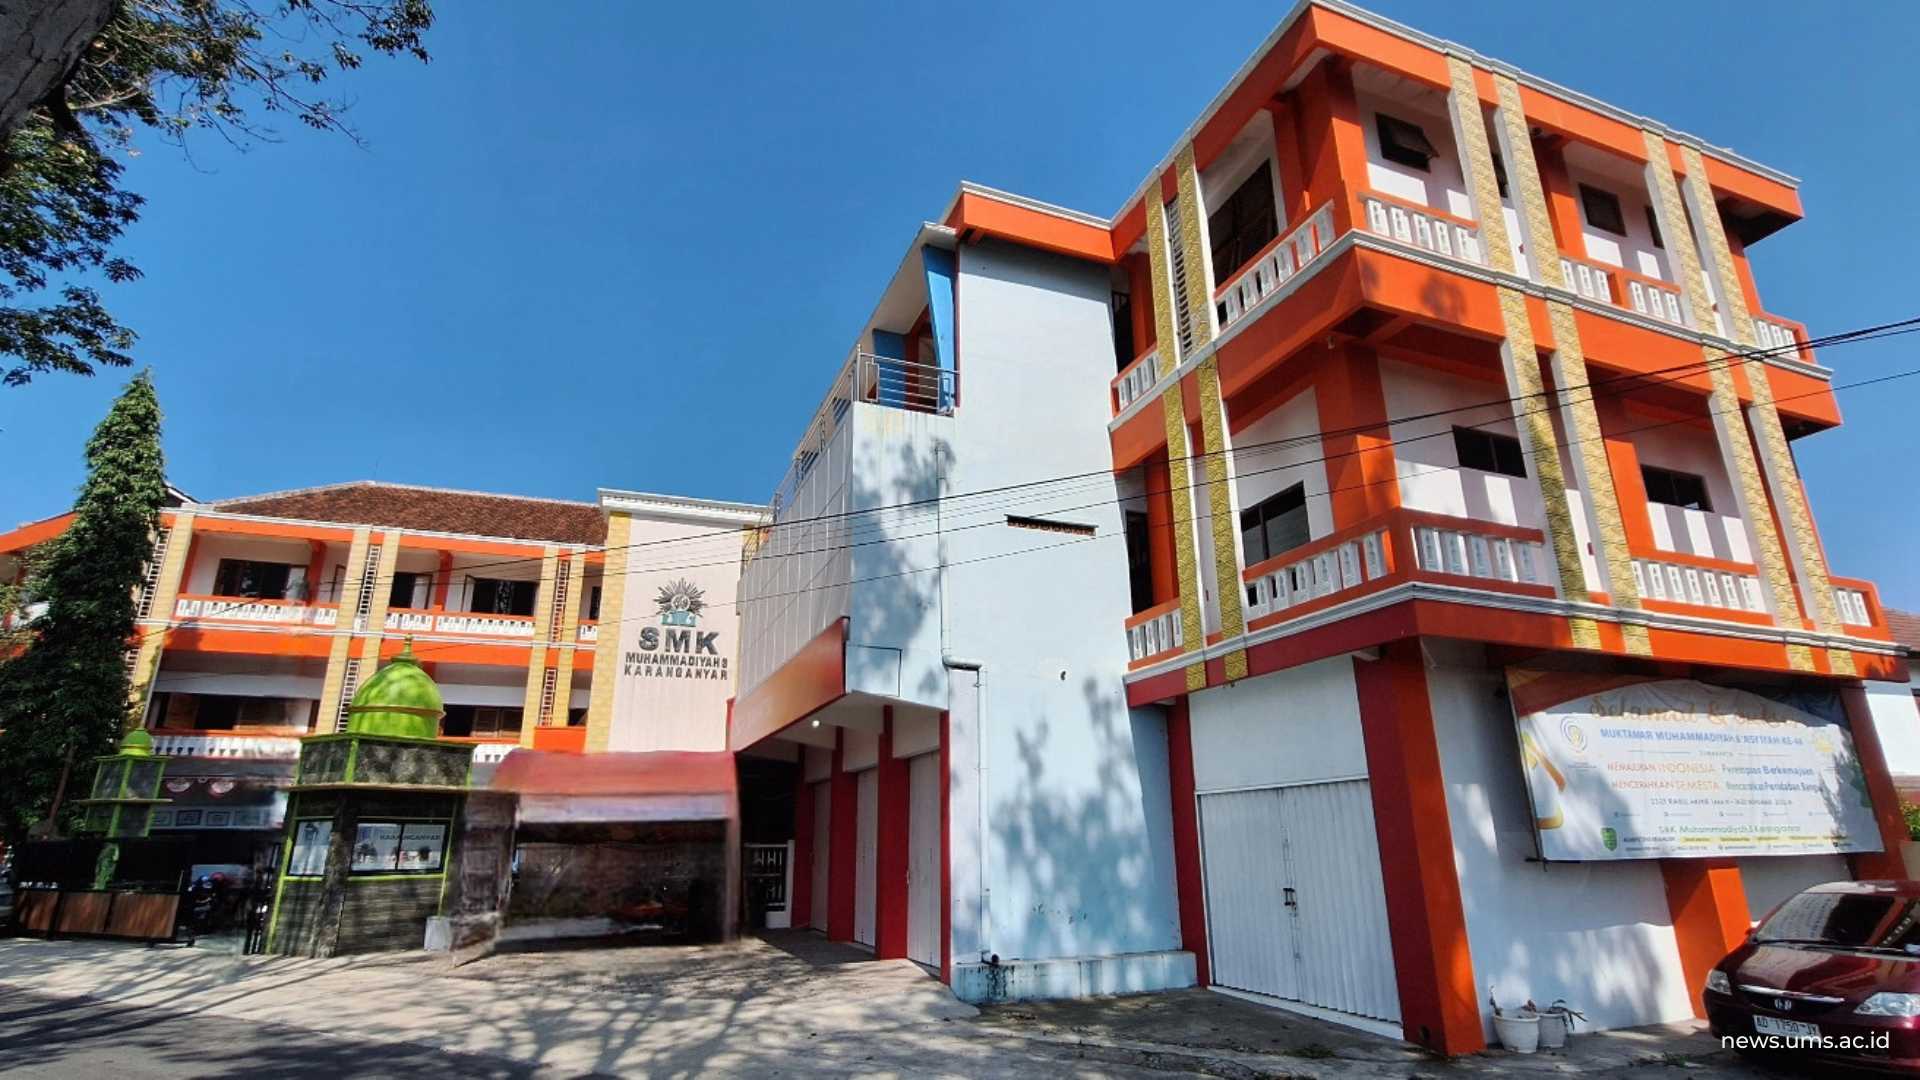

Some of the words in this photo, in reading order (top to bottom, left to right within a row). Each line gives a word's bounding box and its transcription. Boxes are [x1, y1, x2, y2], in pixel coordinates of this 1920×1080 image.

[638, 627, 719, 655] SMK
[625, 652, 720, 667] MUHAMMADIYAH
[624, 664, 728, 680] KARANGANYAR
